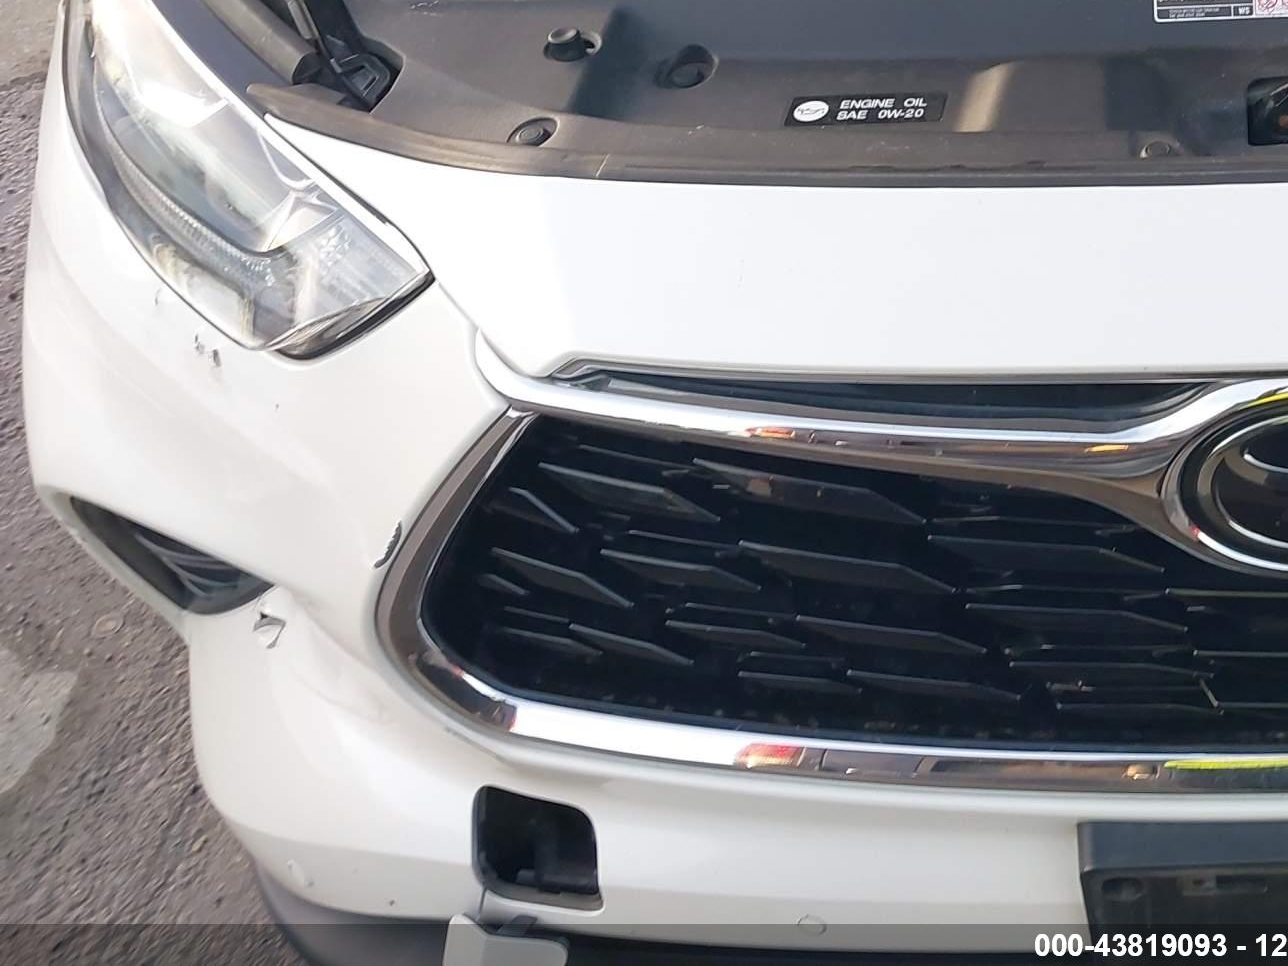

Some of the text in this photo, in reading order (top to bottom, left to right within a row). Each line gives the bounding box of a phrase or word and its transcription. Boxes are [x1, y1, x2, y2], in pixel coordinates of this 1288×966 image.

[840, 97, 927, 109] ENGINE OIL
[836, 108, 924, 121] SAE 0W-20
